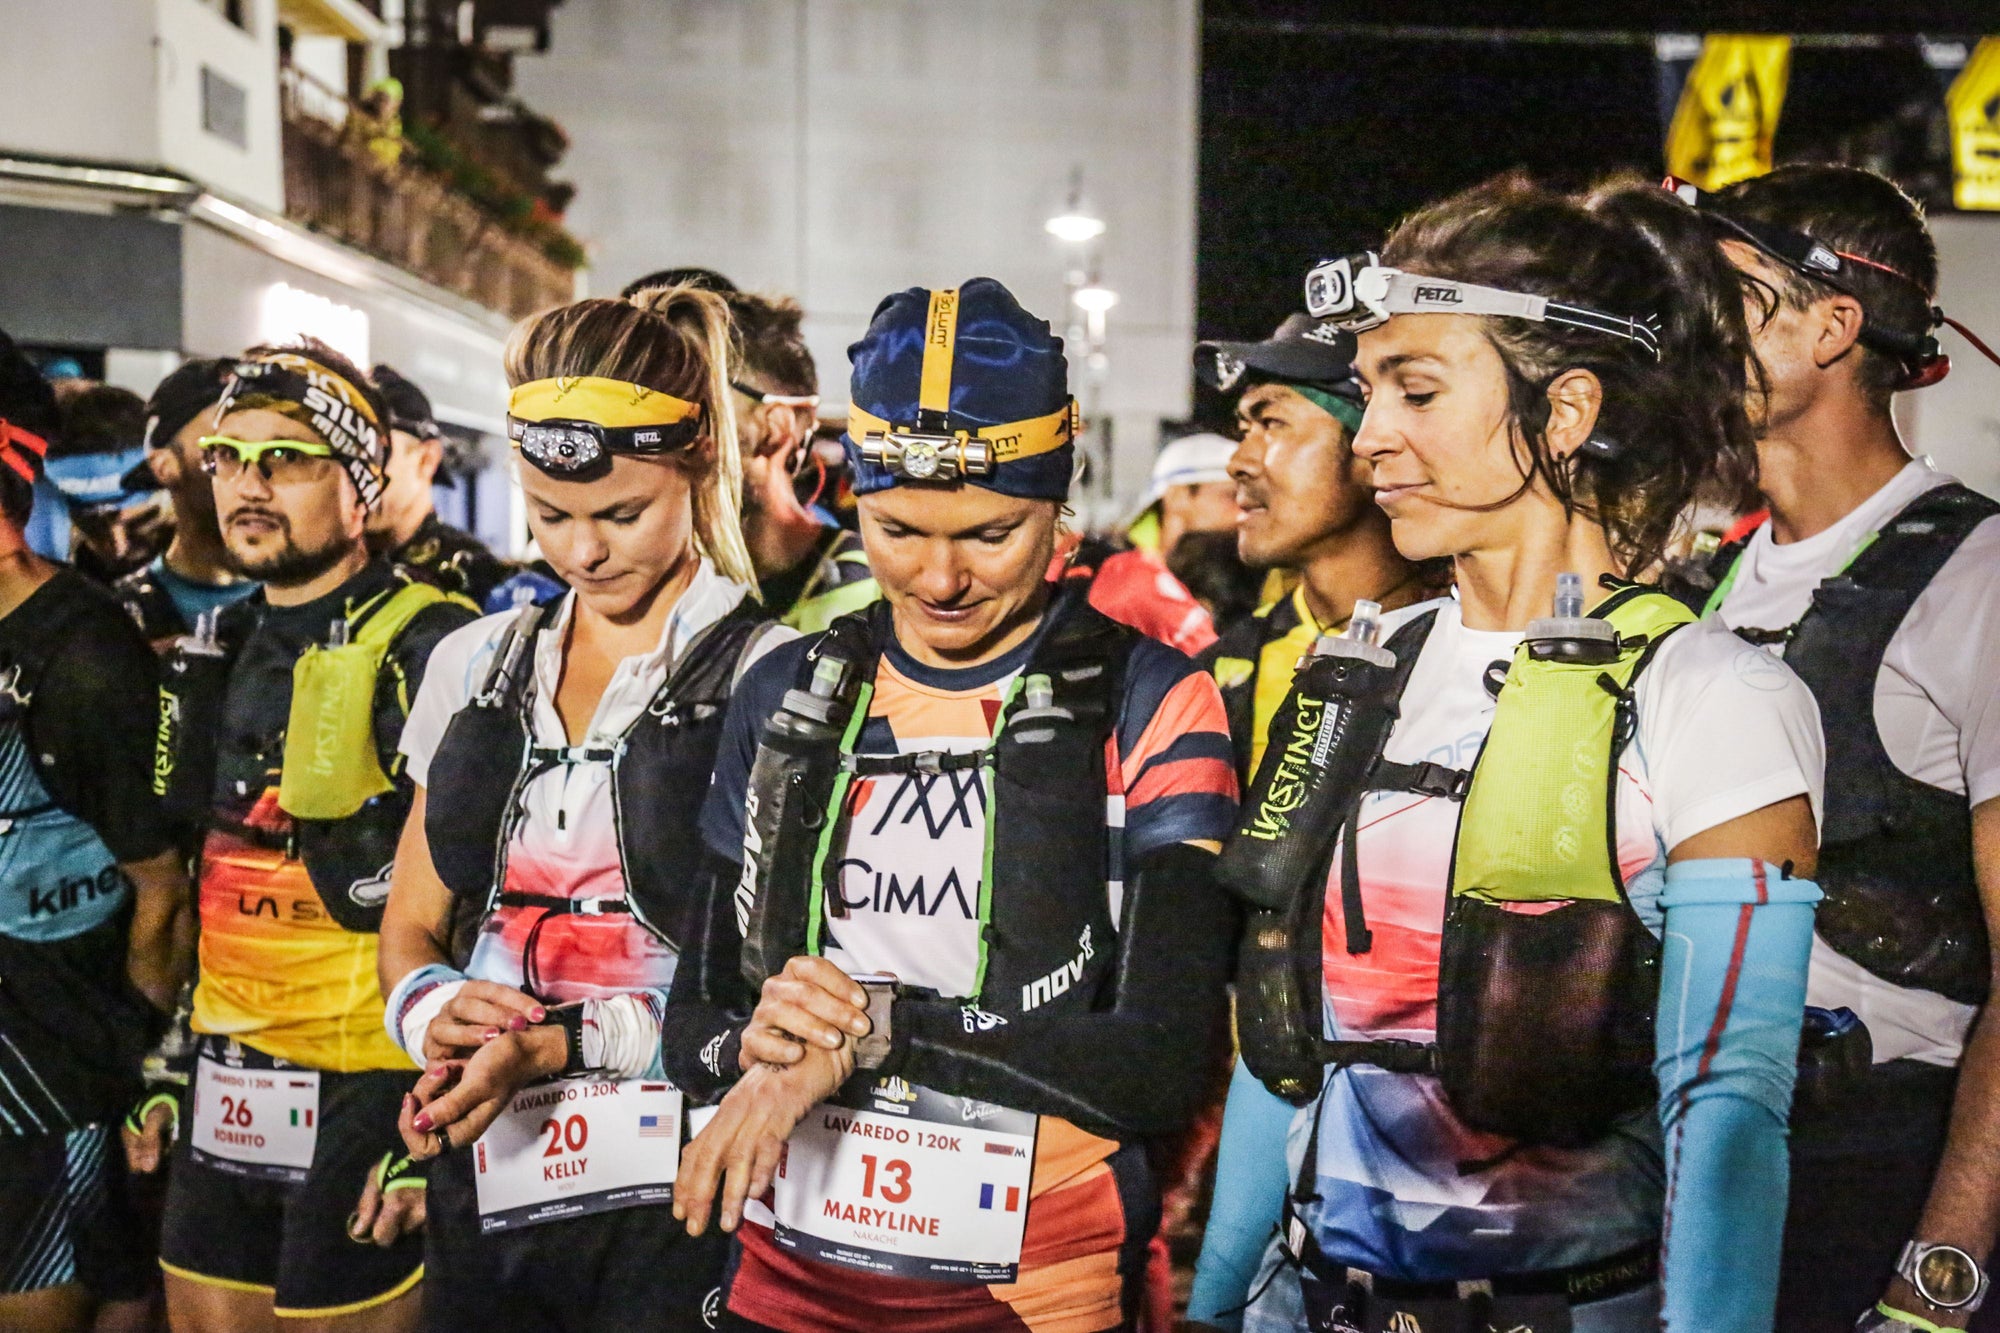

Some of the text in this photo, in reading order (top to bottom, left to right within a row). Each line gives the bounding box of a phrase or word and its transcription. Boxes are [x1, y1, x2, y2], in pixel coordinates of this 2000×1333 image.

[1414, 286, 1463, 304] PETZL
[221, 1095, 253, 1128] 26
[513, 1083, 619, 1114] LAVAREDO 120K
[540, 1114, 588, 1158] 20
[824, 1114, 910, 1144] LAVAREDO
[918, 1132, 961, 1152] 120K
[544, 1158, 588, 1181] KELLY
[861, 1154, 912, 1204] 13
[823, 1199, 940, 1236] MARYLINE
[853, 1230, 898, 1246] NAKACHE
